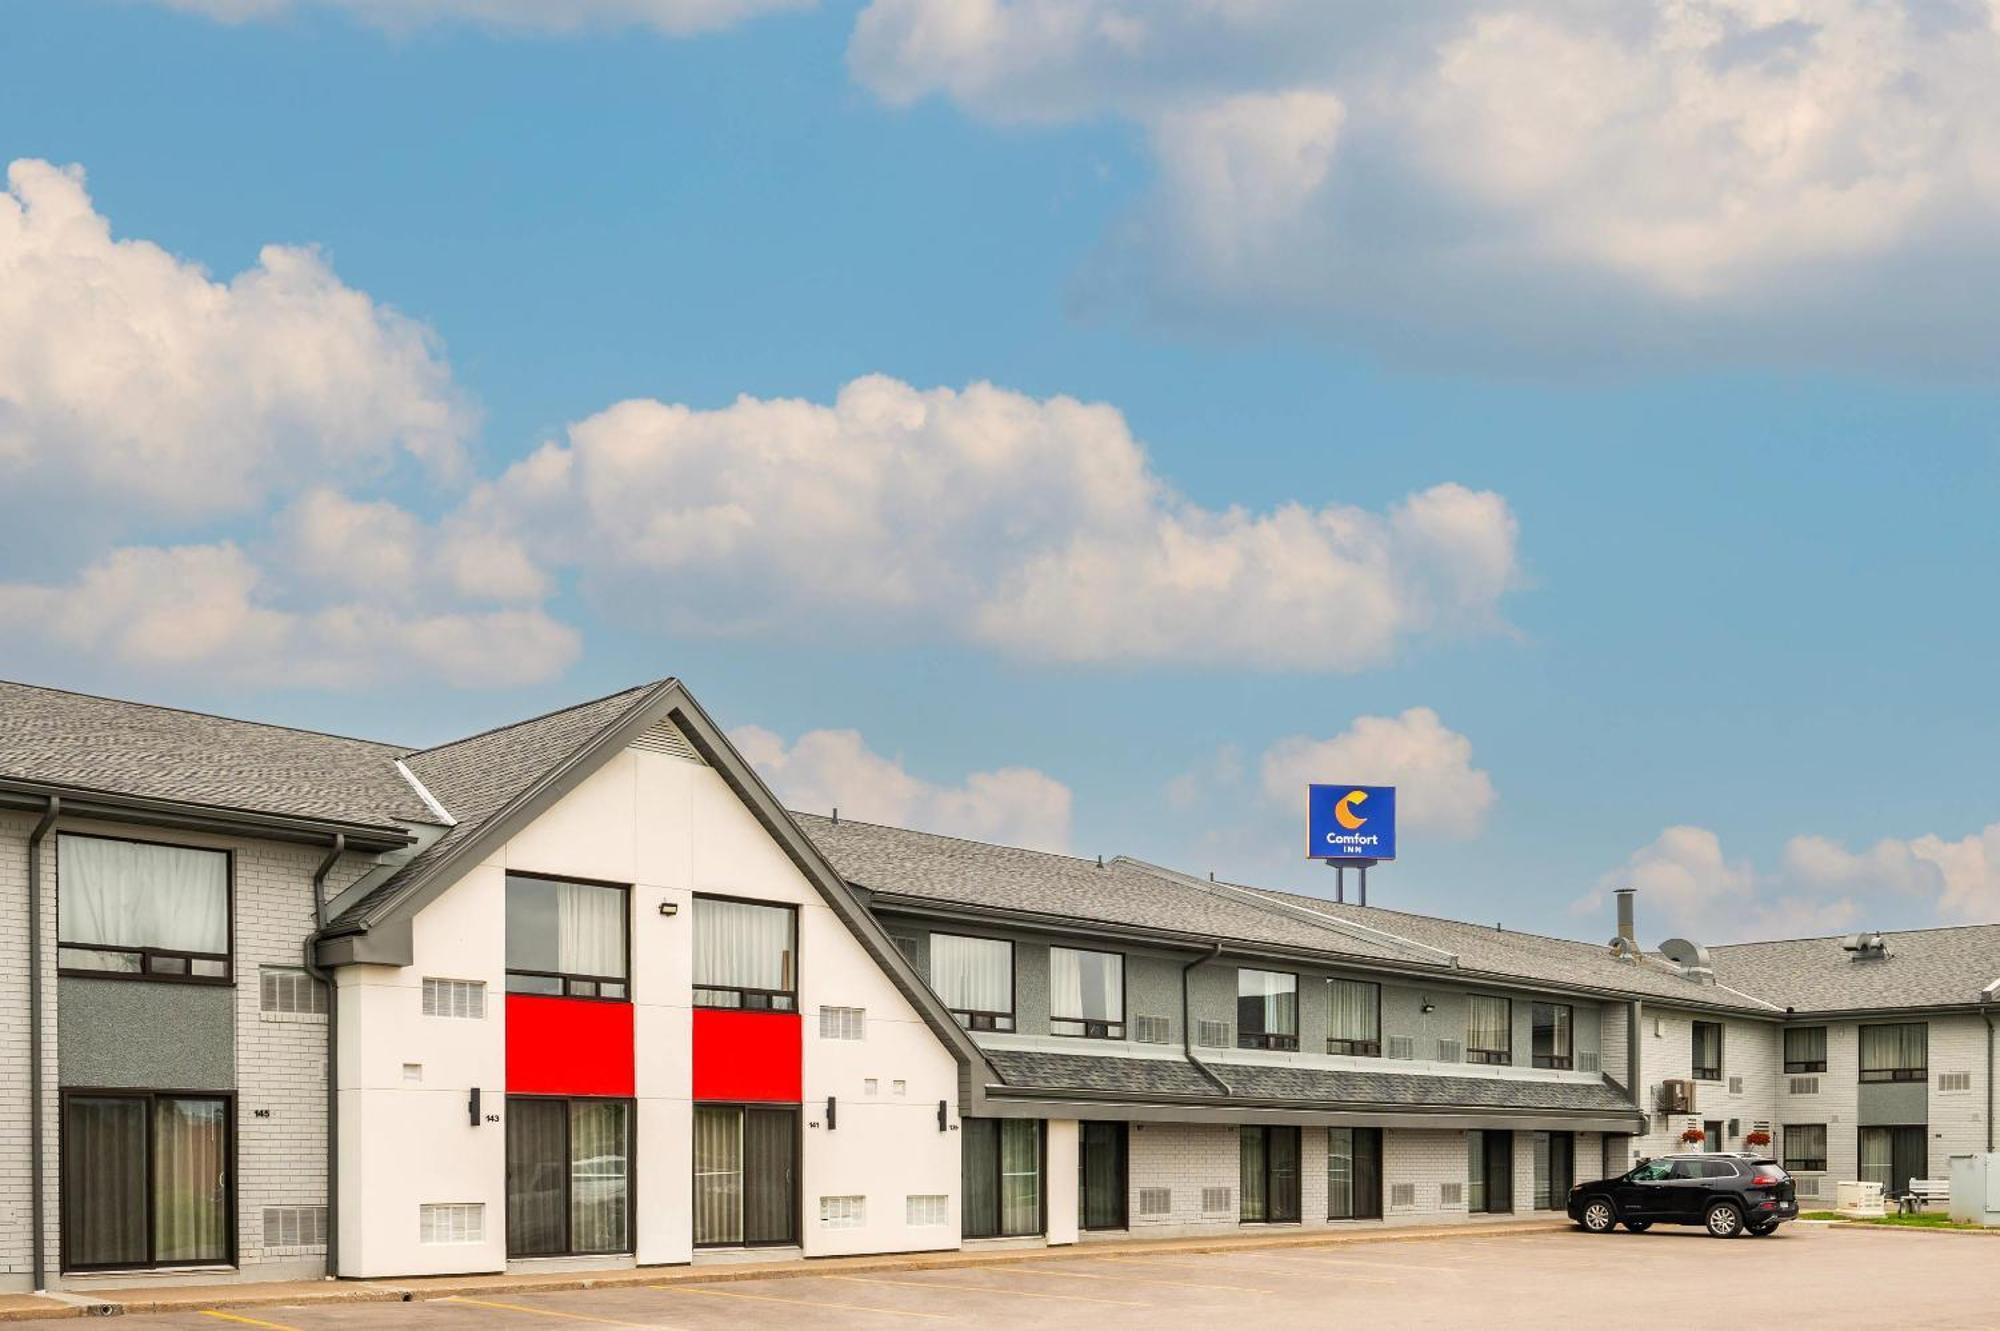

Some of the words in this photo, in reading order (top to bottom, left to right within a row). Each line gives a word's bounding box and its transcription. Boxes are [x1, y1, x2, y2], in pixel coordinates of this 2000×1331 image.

[1326, 832, 1378, 845] Comfort
[254, 1109, 270, 1119] 145
[485, 1114, 499, 1123] 143
